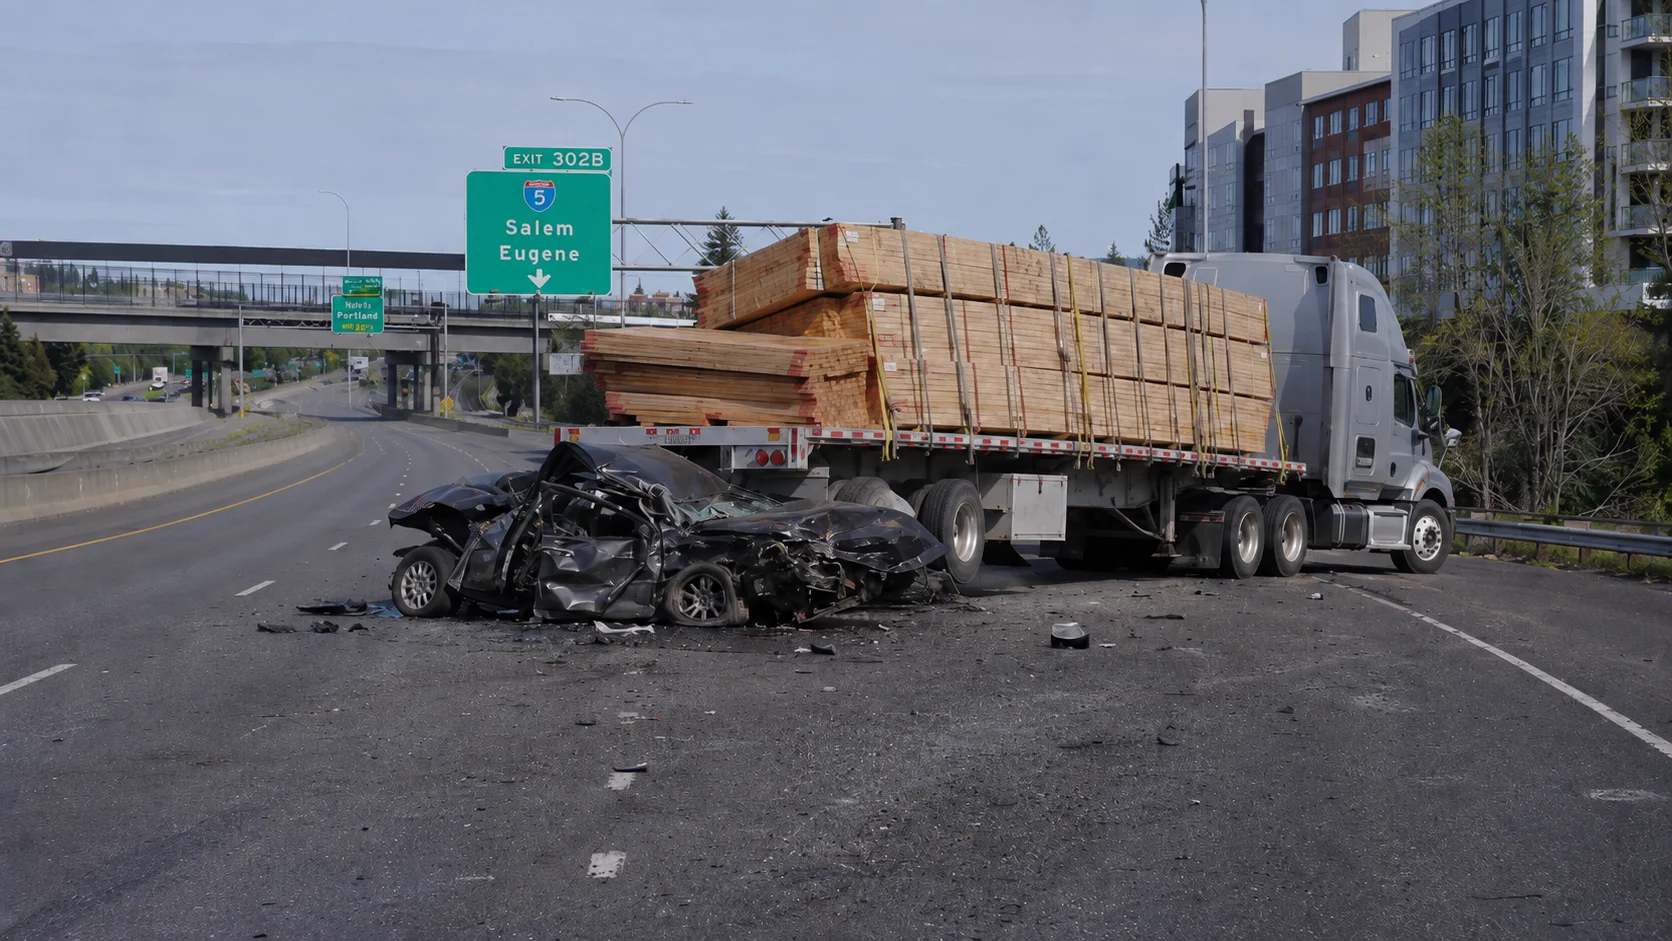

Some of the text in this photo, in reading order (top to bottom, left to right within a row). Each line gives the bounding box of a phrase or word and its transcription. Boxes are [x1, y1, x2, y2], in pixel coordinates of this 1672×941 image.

[513, 152, 604, 167] EXIT 302B
[534, 189, 546, 206] 5
[505, 219, 574, 236] Salem
[499, 245, 580, 265] Eugene
[337, 311, 378, 320] Portland
